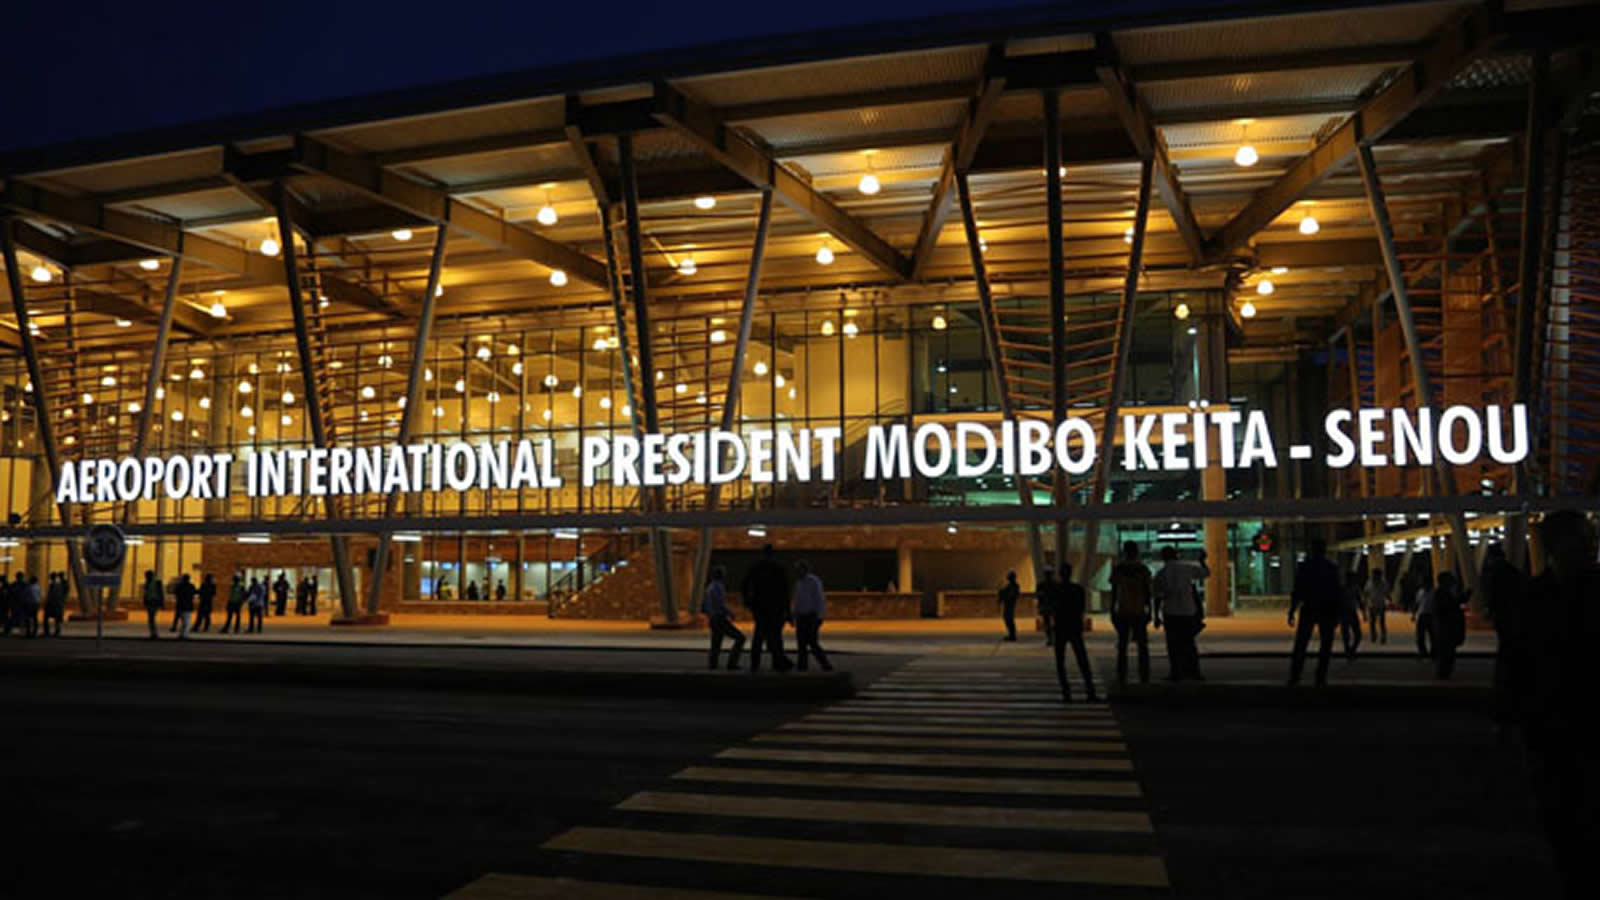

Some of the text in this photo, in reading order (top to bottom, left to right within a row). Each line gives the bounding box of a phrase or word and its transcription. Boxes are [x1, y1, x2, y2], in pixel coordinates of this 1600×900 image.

[57, 401, 1529, 503] AEROPORT INTERNATIONAL PRESIDENT MODIBO KEÏTA - SENOU
[93, 537, 117, 558] 30
